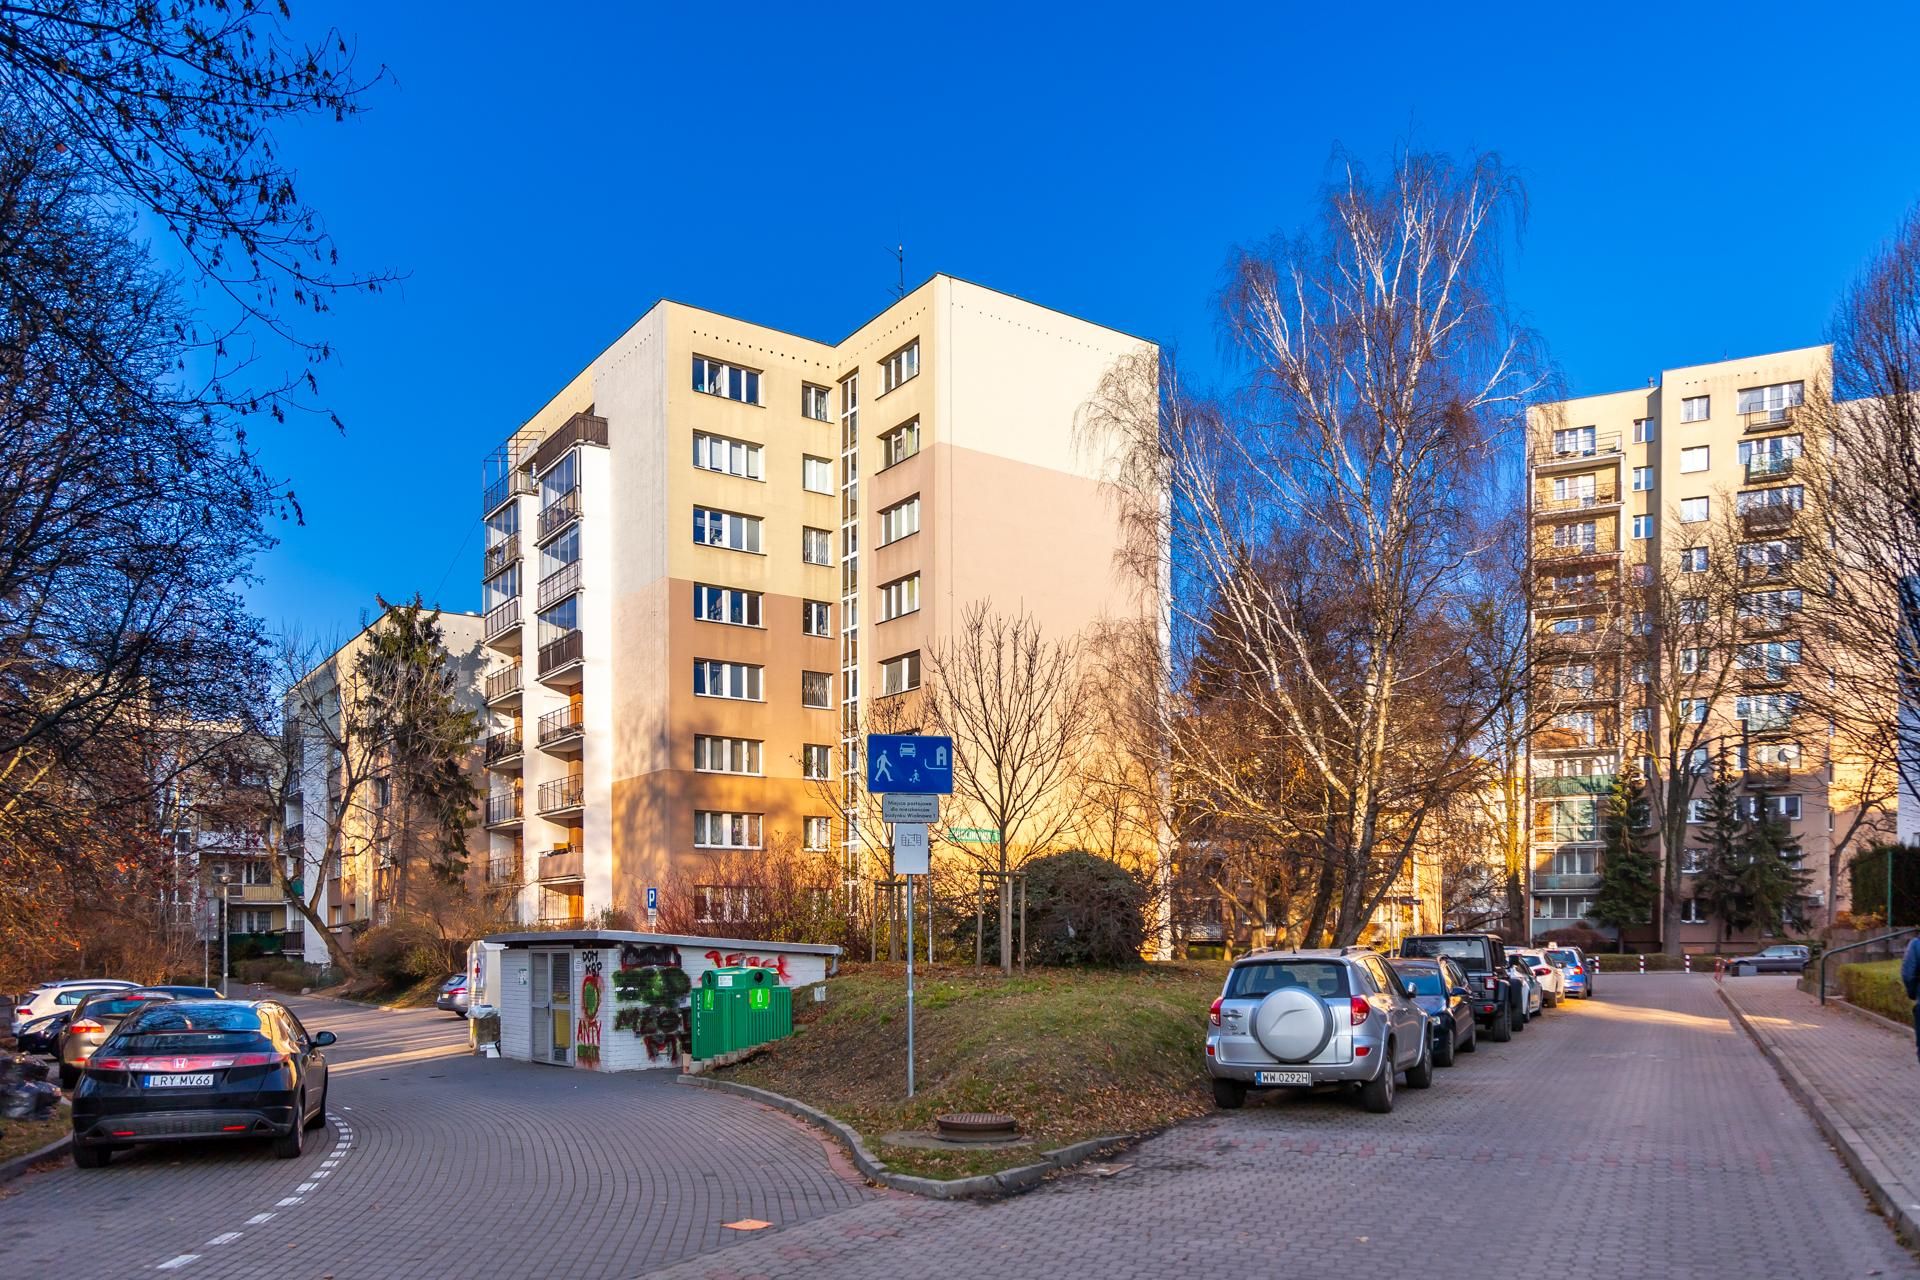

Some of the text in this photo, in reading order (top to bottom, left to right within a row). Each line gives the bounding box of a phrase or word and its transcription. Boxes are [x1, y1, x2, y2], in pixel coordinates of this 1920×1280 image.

[649, 890, 655, 907] P
[582, 950, 599, 962] DOM
[152, 1075, 210, 1087] LRY MV66
[1263, 1073, 1308, 1083] WW 0292H
